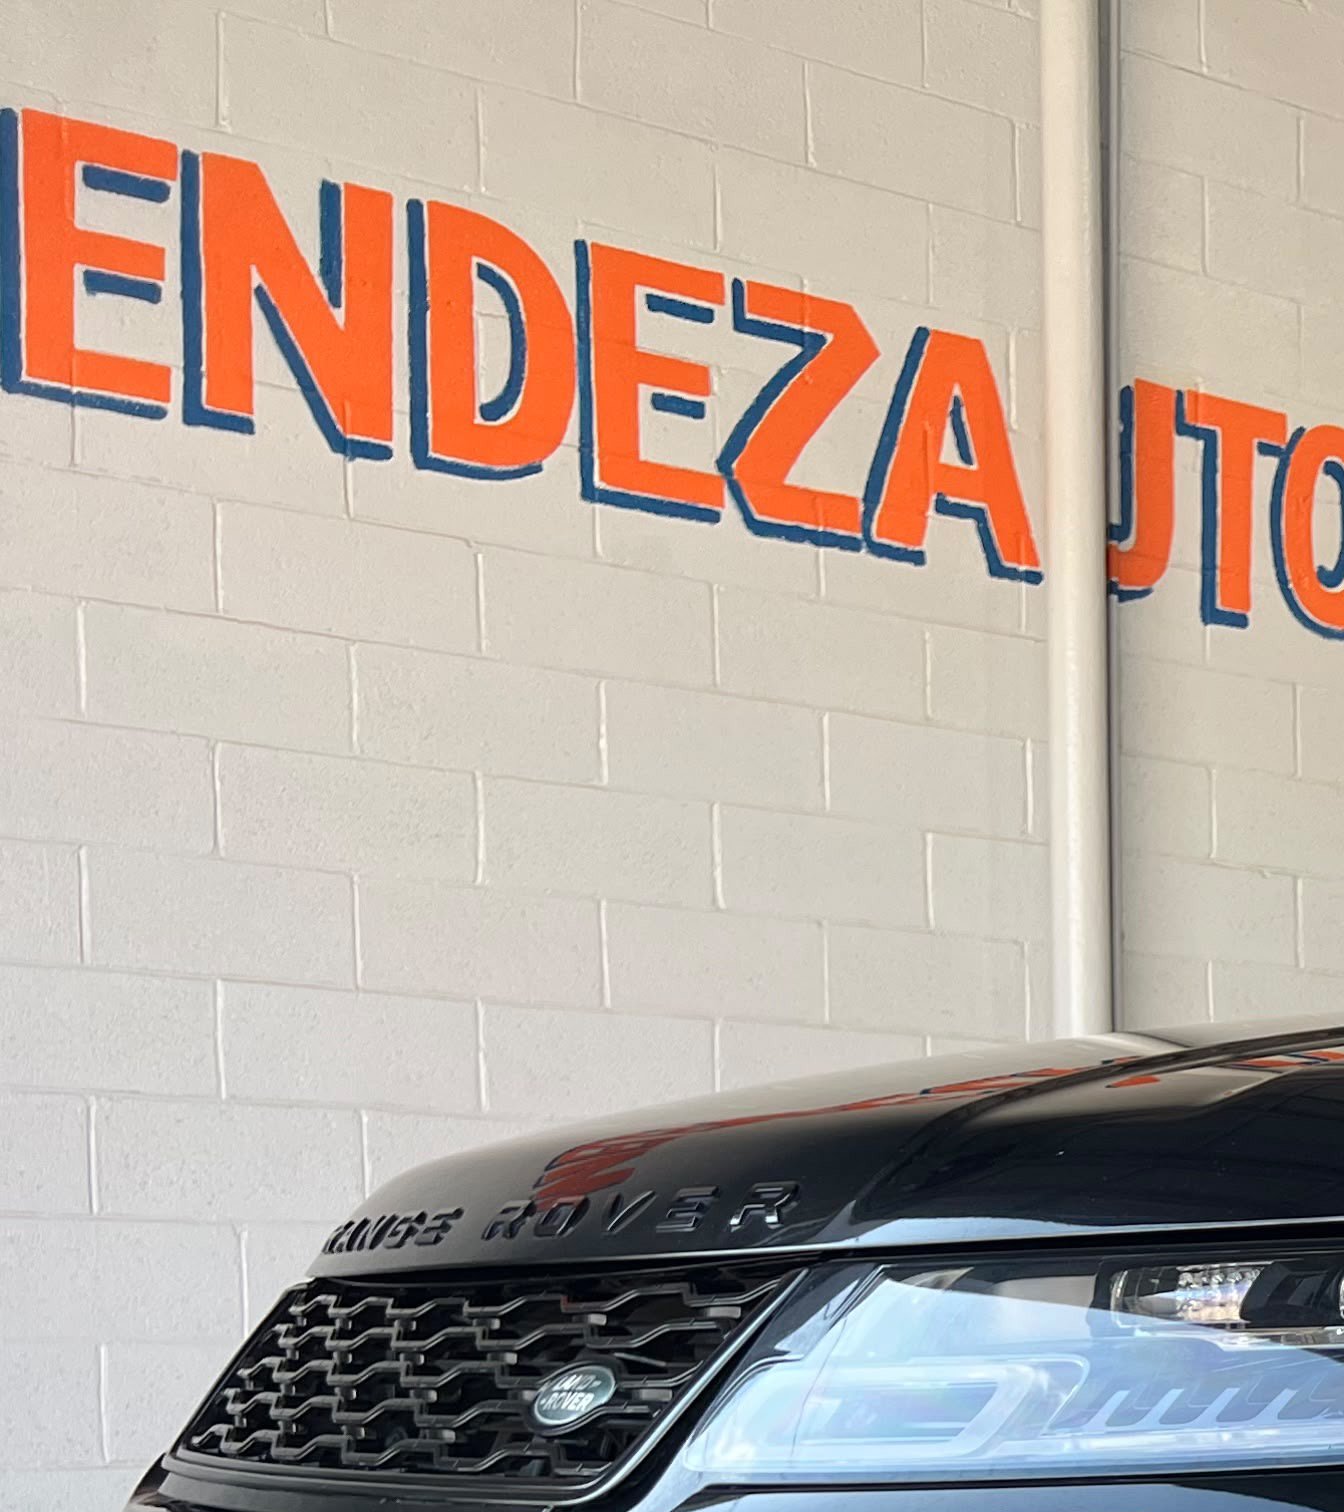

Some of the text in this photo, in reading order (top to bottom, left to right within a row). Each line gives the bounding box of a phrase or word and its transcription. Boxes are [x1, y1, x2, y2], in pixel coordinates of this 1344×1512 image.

[480, 1180, 799, 1241] ROVER
[551, 1374, 597, 1392] LAND
[542, 1391, 596, 1412] ROVER
